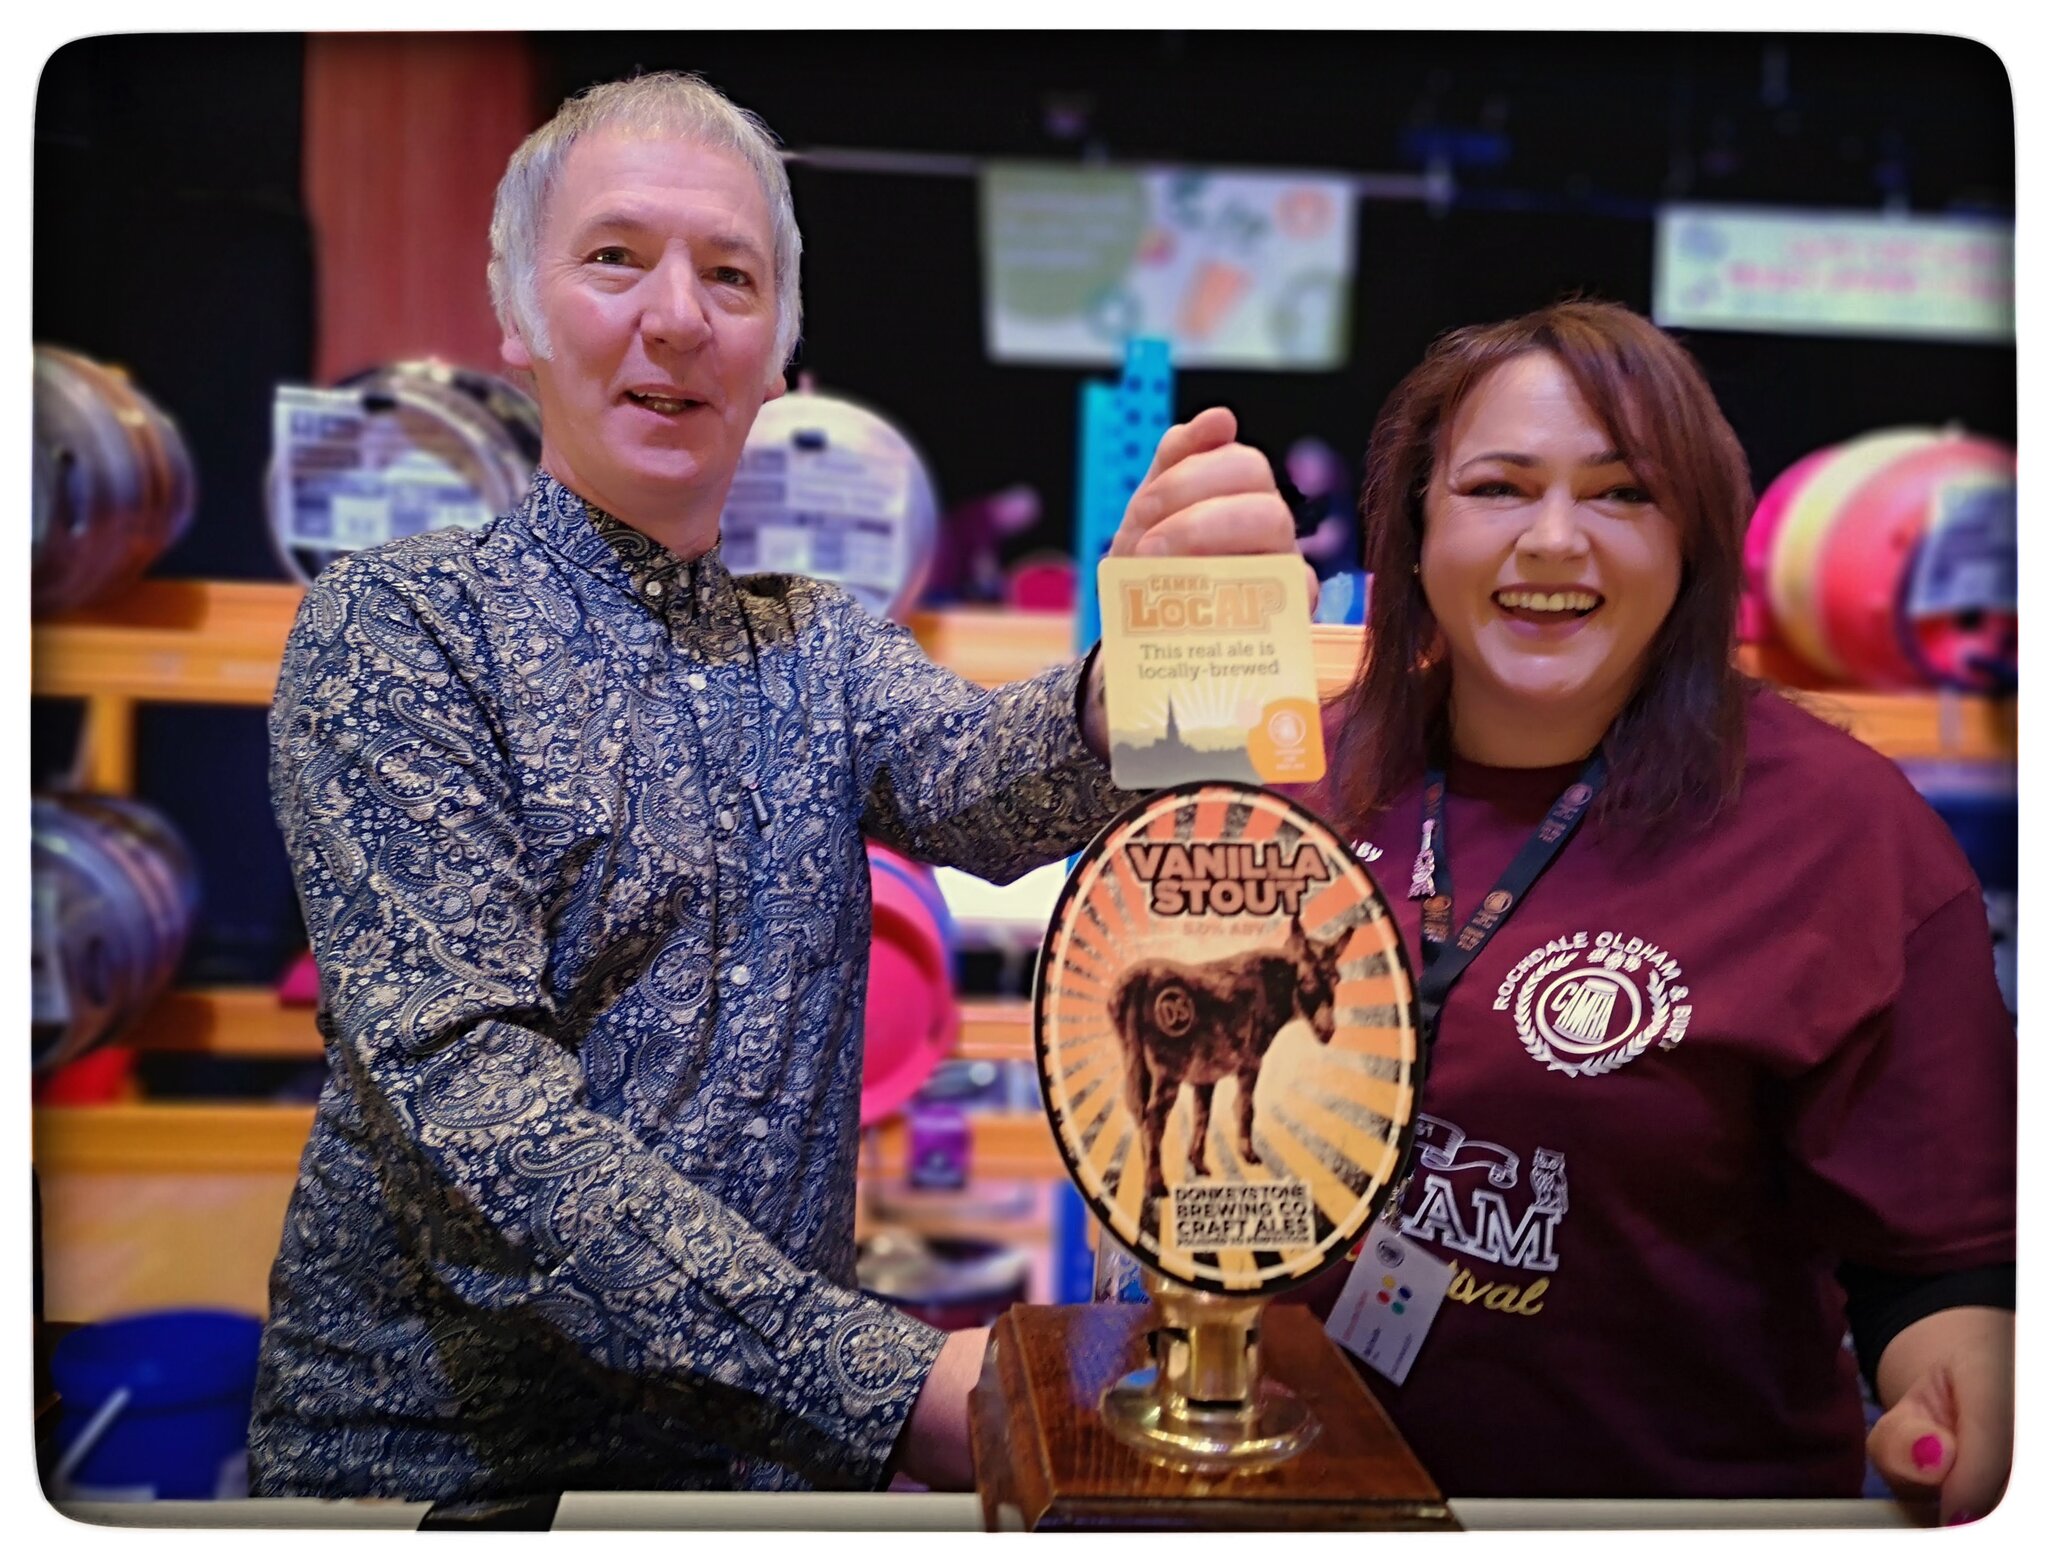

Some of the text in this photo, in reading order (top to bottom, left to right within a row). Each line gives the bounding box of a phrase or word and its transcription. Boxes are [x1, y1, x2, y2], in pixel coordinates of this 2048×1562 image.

[1139, 640, 1275, 660] This real ale is
[1138, 659, 1280, 681] locally-brewed
[1126, 843, 1330, 881] VANILLA
[1150, 878, 1307, 916] STOUT
[1493, 931, 1589, 1010] ROCHDALE
[1595, 931, 1682, 981] OLDHAM
[1669, 985, 1689, 1003] &
[1551, 981, 1618, 1042] CAMRA
[1176, 1185, 1306, 1200] DONKEYSTONE
[1177, 1202, 1272, 1218] BREWING
[1177, 1218, 1309, 1236] CRAFT ALES
